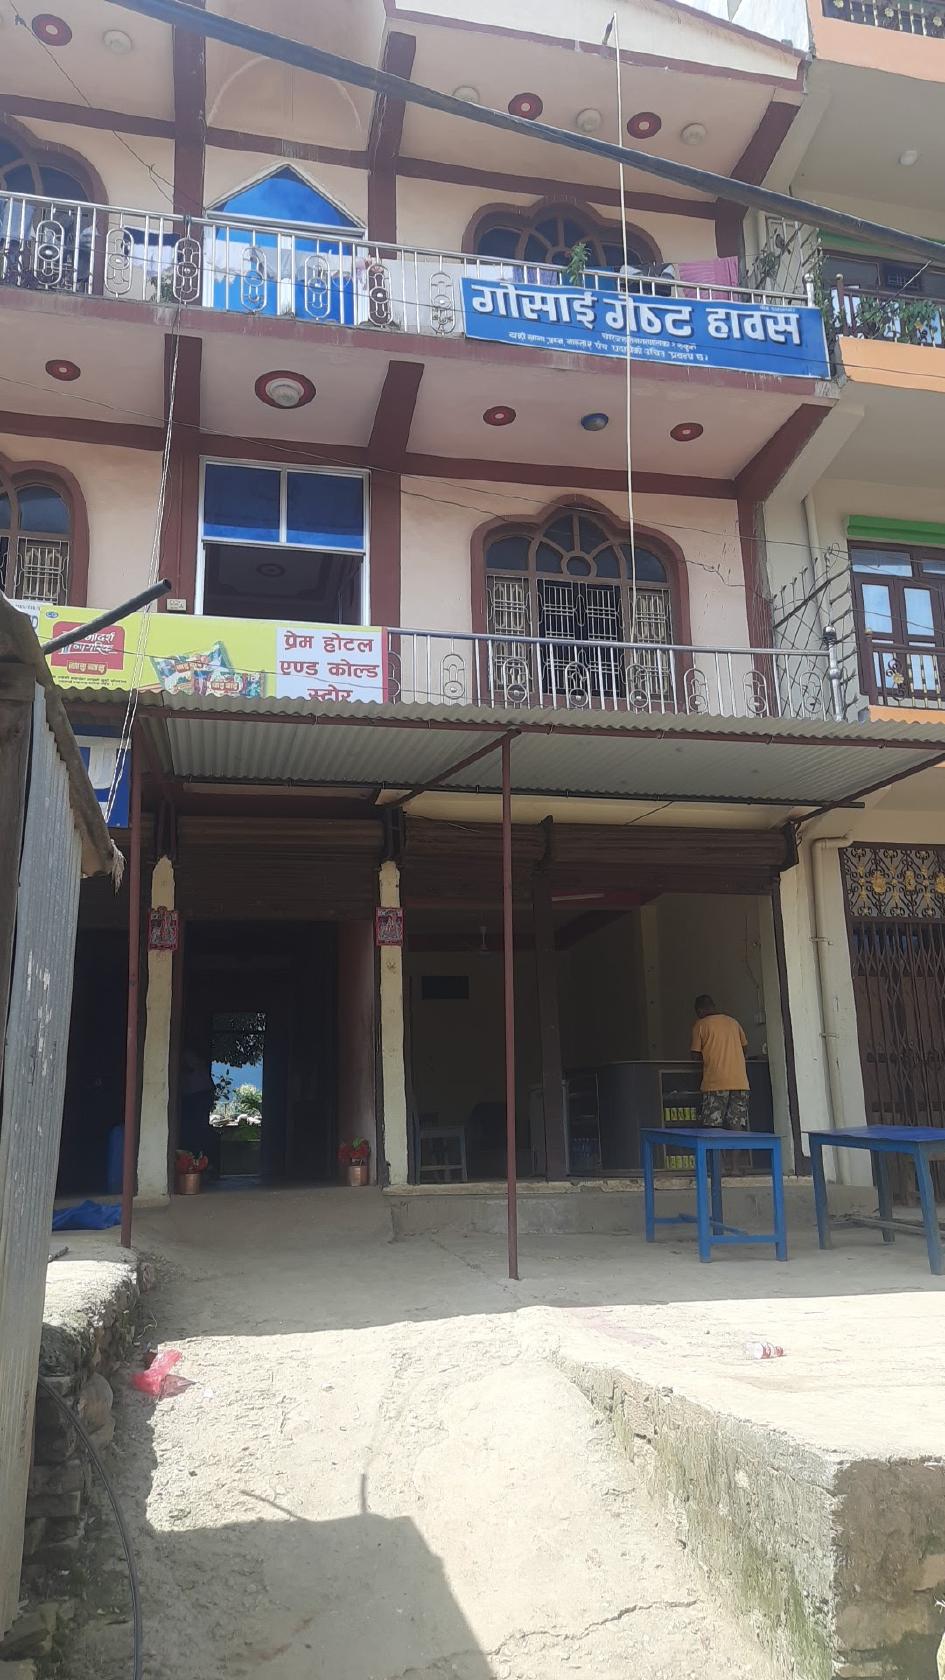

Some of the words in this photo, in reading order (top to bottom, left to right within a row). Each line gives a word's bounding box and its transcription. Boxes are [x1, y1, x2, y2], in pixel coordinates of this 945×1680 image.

[284, 630, 314, 650] प्रेम
[322, 632, 374, 653] होटल
[280, 660, 319, 675] एण्ड
[327, 658, 380, 678] कोल्ड
